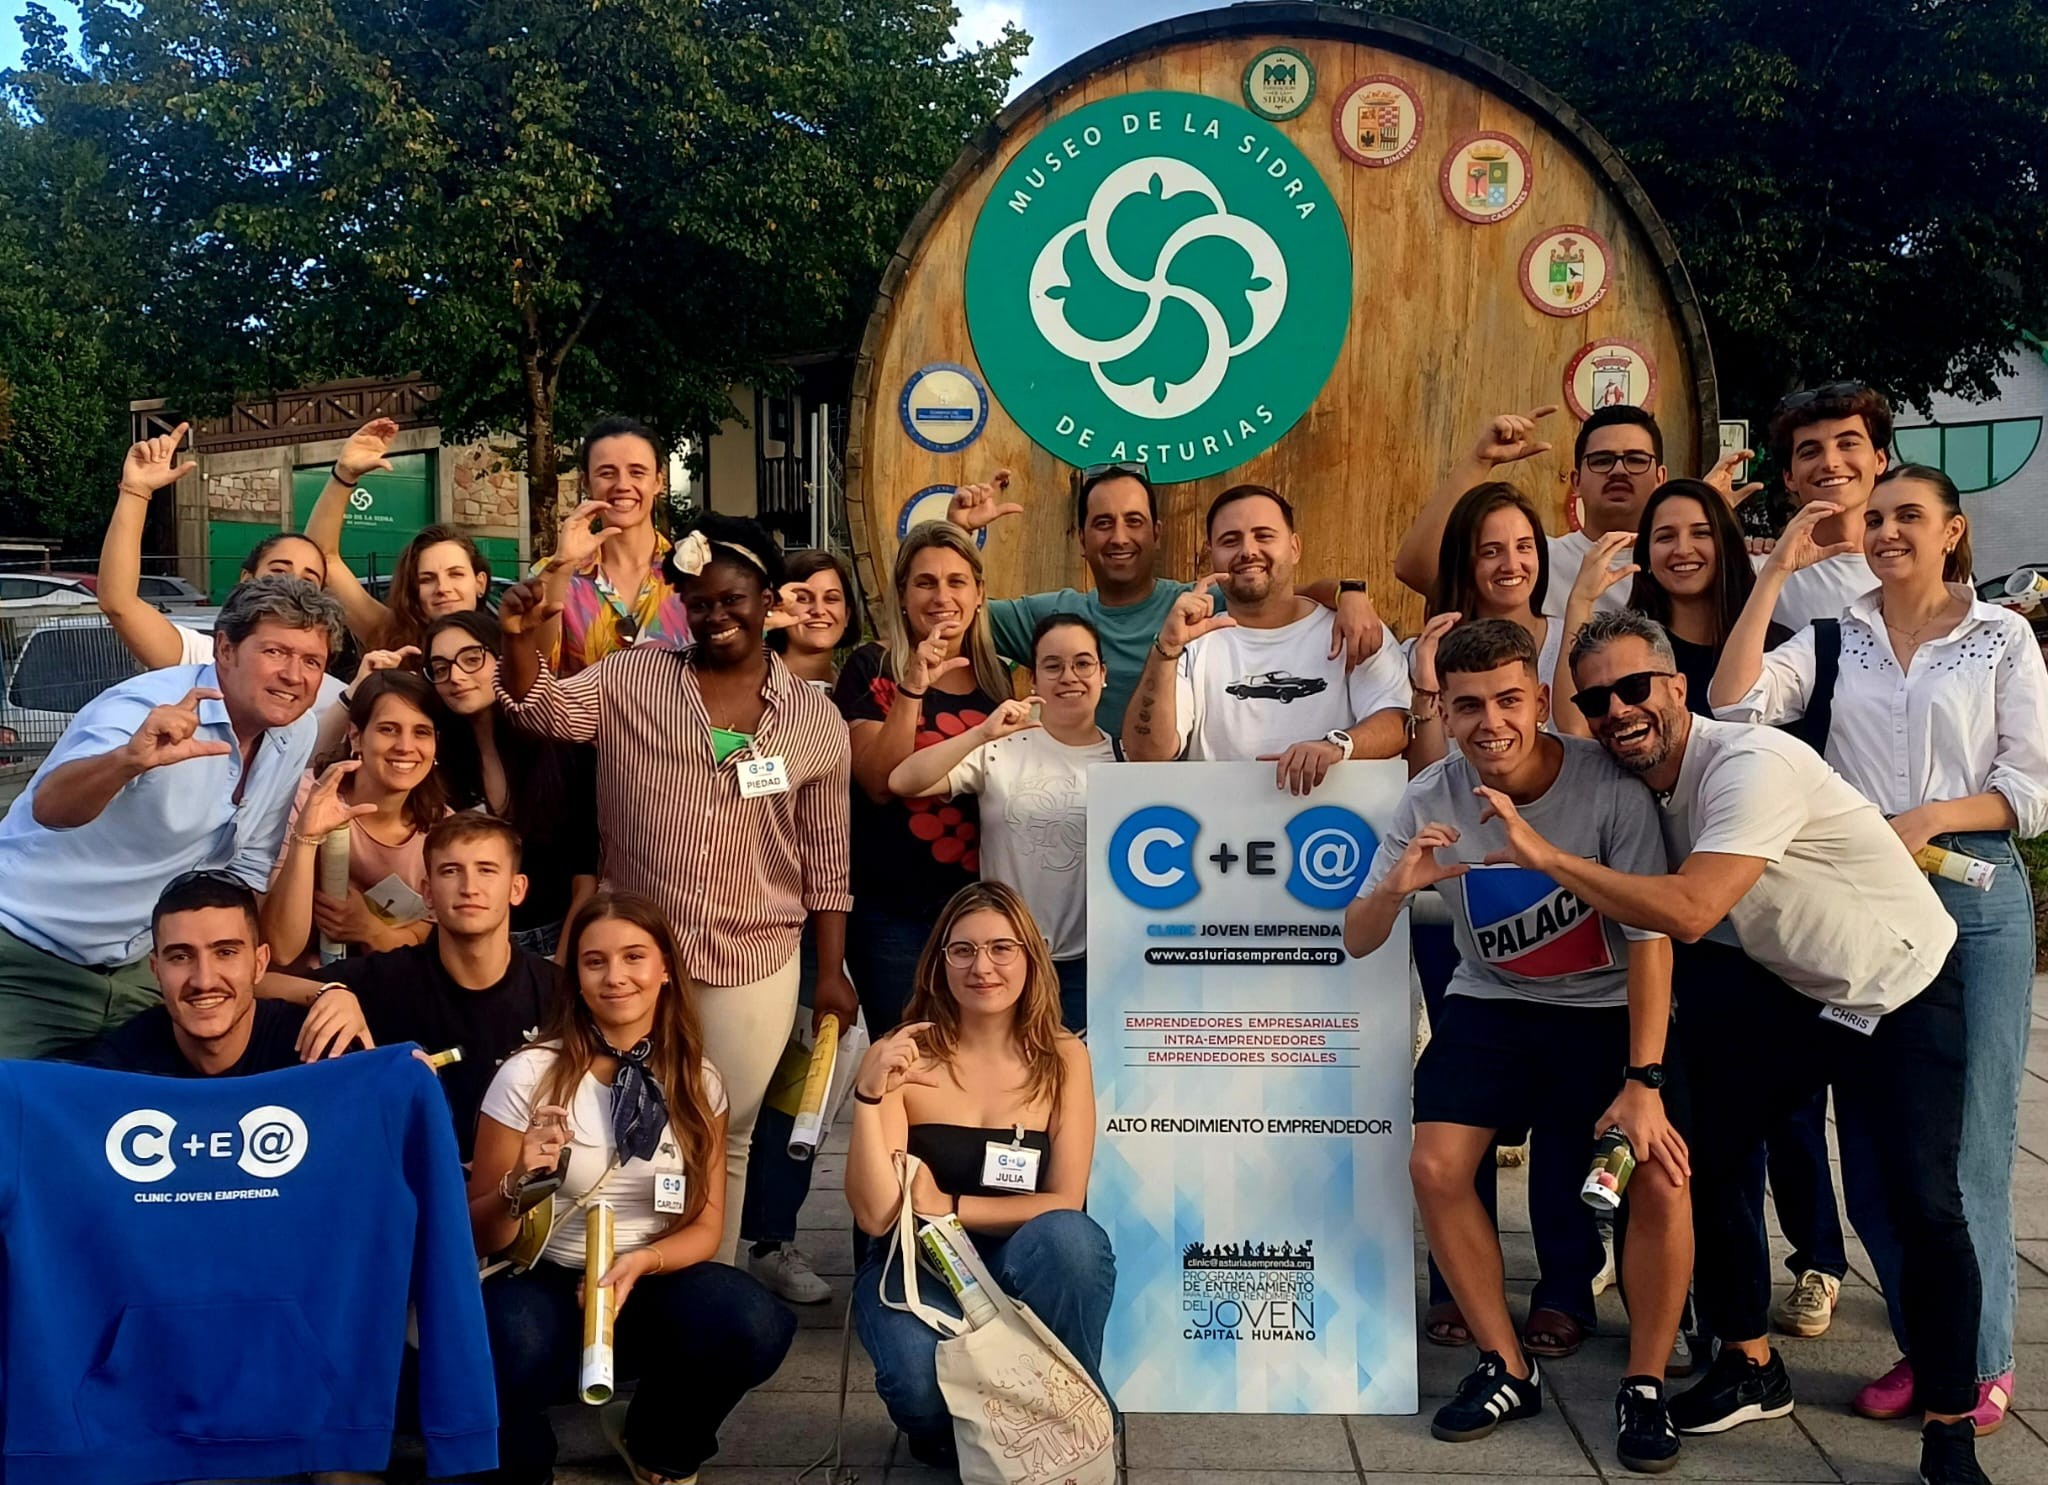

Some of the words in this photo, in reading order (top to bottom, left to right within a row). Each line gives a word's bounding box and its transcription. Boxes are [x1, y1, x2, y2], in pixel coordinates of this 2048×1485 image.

[1263, 95, 1295, 104] SIDRA
[1008, 126, 1102, 215] MUSEO
[1122, 111, 1162, 134] DE
[1184, 113, 1220, 138] LA
[1238, 135, 1317, 220] SIDRA
[1055, 415, 1095, 448] DE
[1111, 404, 1274, 464] ASTURIAS
[746, 777, 781, 790] PIEDAD
[1200, 924, 1250, 937] JOVEN
[1253, 924, 1342, 937] EMPRENDA
[1150, 947, 1338, 964] www.asturiasemprenda.org
[1125, 1017, 1243, 1029] EMPRENDEDORES
[1248, 1017, 1359, 1030] EMPRESARIALES
[1831, 1007, 1870, 1029] CHRIS
[1163, 1034, 1326, 1046] INTRA-EMPRENDEDORES
[1147, 1051, 1265, 1063] EMPRENDEDORES
[1270, 1052, 1337, 1064] SOCIALES
[1106, 1118, 1147, 1133] ALTO
[1150, 1119, 1264, 1134] RENDIMIENTO
[1267, 1119, 1392, 1135] EMPRENDEDOR
[995, 1173, 1025, 1184] JULIA
[134, 1191, 173, 1203] CLINIC
[175, 1191, 212, 1203] JOVEN
[214, 1187, 279, 1201] EMPRENDA
[1187, 1258, 1311, 1270] clinic@asturiasemprenda.org
[1183, 1270, 1254, 1281] PROGRAMA
[1259, 1271, 1314, 1281] PIONERO
[1183, 1281, 1201, 1292] DE
[1205, 1281, 1314, 1293] ENTRENAMIENTO
[1213, 1292, 1240, 1301] ALTO
[1244, 1292, 1314, 1302] RENDIMIENTO
[1182, 1300, 1208, 1311] DEL
[1192, 1300, 1314, 1329] JOVEN
[1183, 1329, 1243, 1340] CAPITAL
[1252, 1329, 1316, 1341] HUMANO
